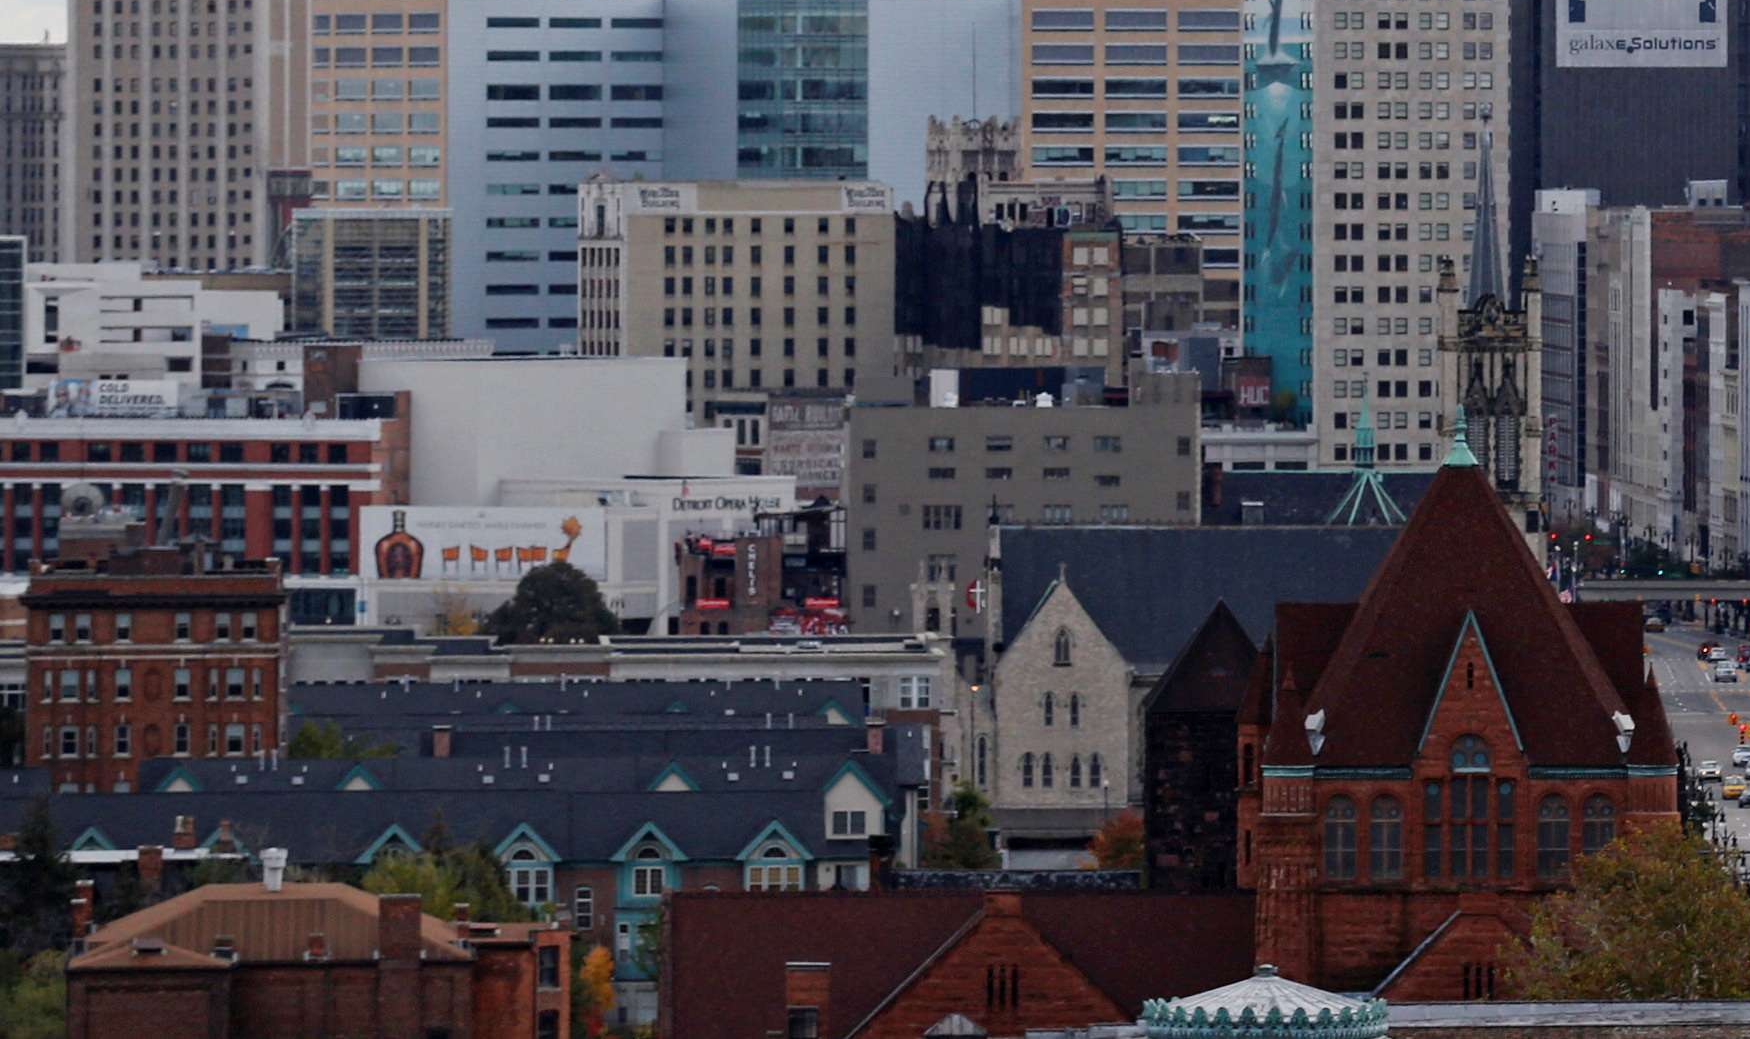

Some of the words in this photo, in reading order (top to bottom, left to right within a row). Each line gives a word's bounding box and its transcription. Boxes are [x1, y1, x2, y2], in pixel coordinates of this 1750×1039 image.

[1548, 417, 1557, 471] PARK
[672, 498, 712, 511] DETROIT
[715, 497, 746, 511] OPERA
